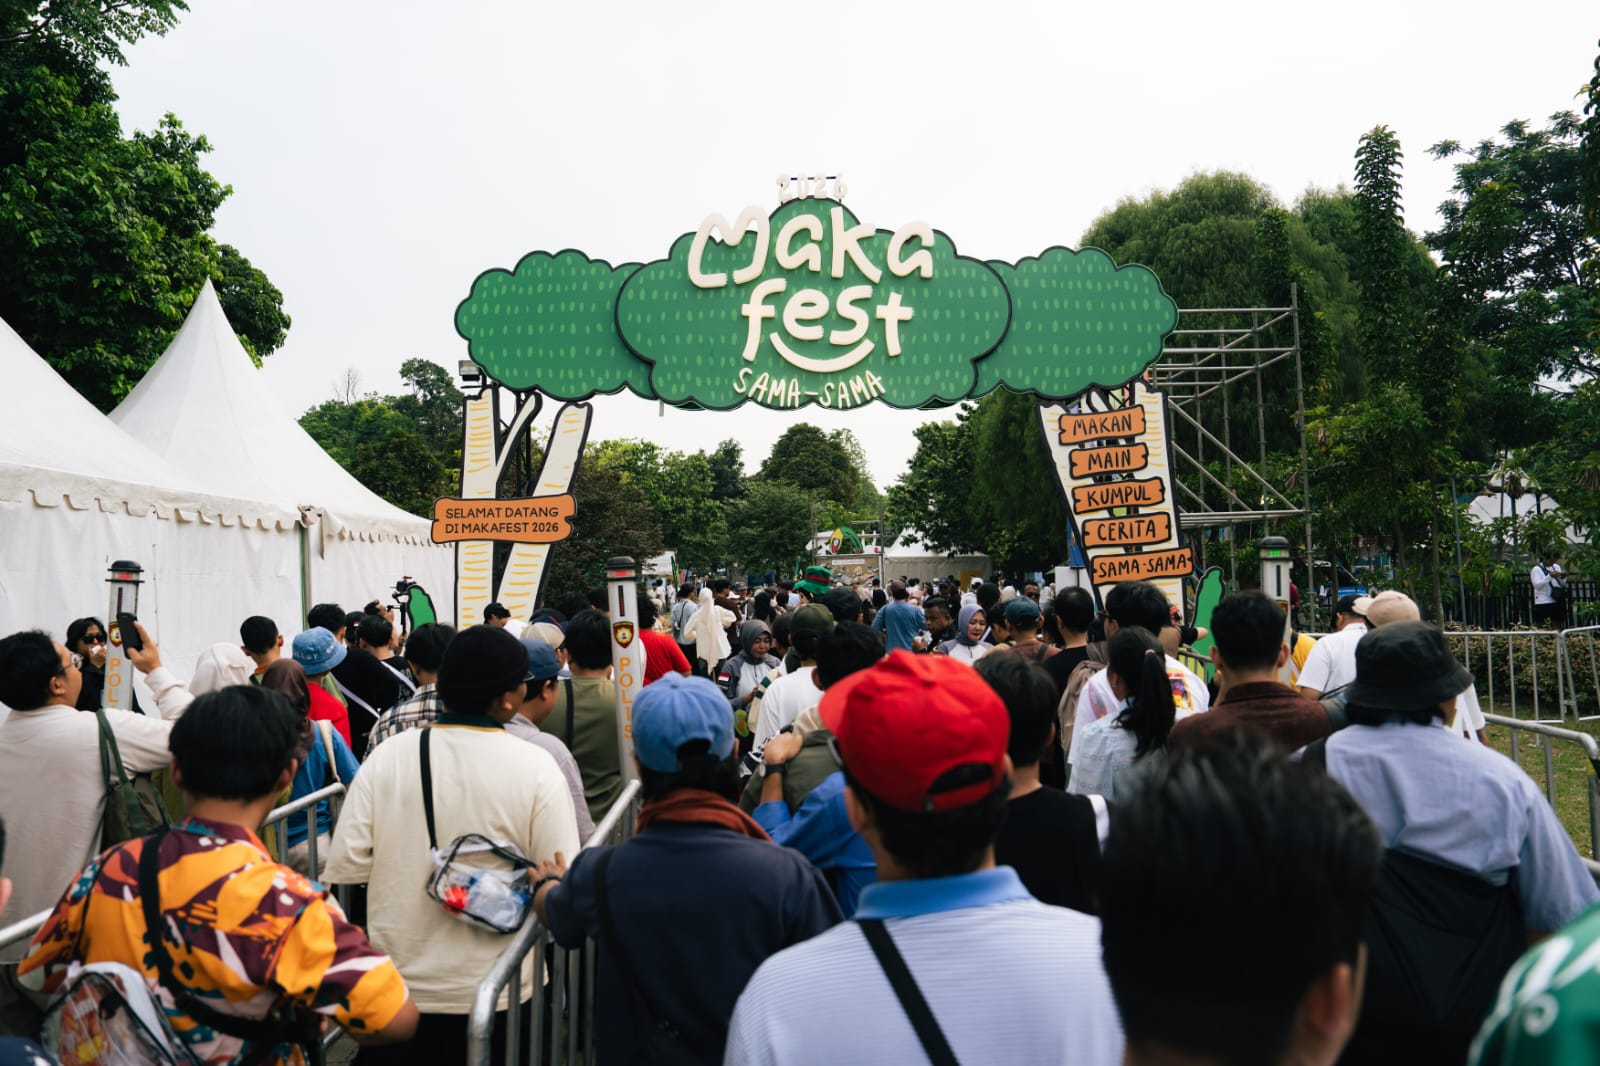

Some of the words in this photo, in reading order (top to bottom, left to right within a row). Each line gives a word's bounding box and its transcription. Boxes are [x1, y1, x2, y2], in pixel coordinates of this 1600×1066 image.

[776, 173, 848, 202] 2026
[741, 278, 914, 361] fest
[1073, 413, 1132, 436] MAKAN
[1088, 449, 1131, 470] MAIN
[1087, 485, 1151, 506] KUMPUL
[446, 507, 502, 519] SELAMAT
[505, 506, 559, 518] DATANG
[445, 524, 459, 534] DI
[462, 522, 529, 534] MAKAFEST
[532, 522, 559, 533] 2026
[1097, 518, 1156, 541] CERITA
[1098, 554, 1187, 578] SAMA-SAMA
[107, 657, 121, 709] POL
